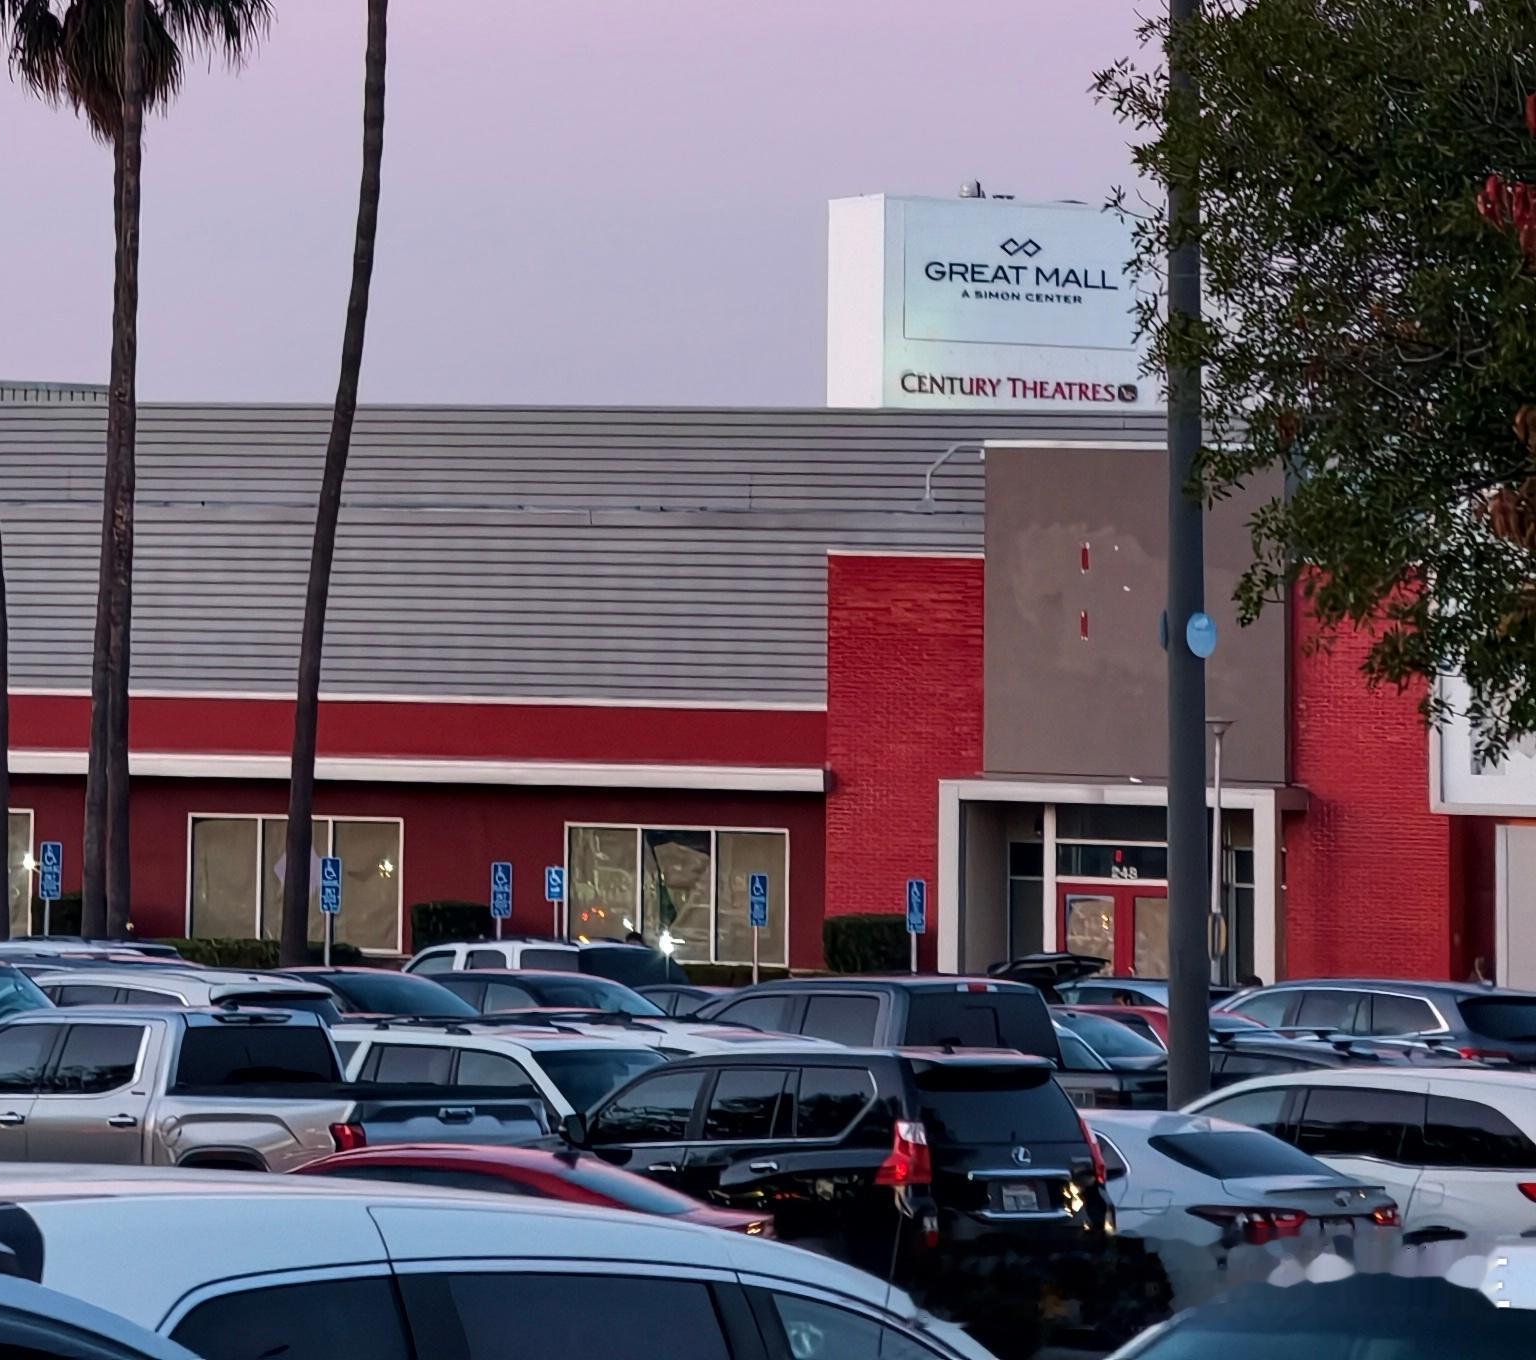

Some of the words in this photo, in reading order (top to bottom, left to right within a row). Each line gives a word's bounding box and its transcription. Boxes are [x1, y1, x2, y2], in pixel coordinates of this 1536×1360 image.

[924, 261, 1028, 286] GREAT
[1035, 266, 1119, 291] MALL
[961, 289, 971, 299] A
[974, 290, 1021, 302] SIMON
[1025, 292, 1083, 305] CENTER
[900, 372, 1002, 398] CENTURY
[1007, 377, 1116, 403] THEATRES
